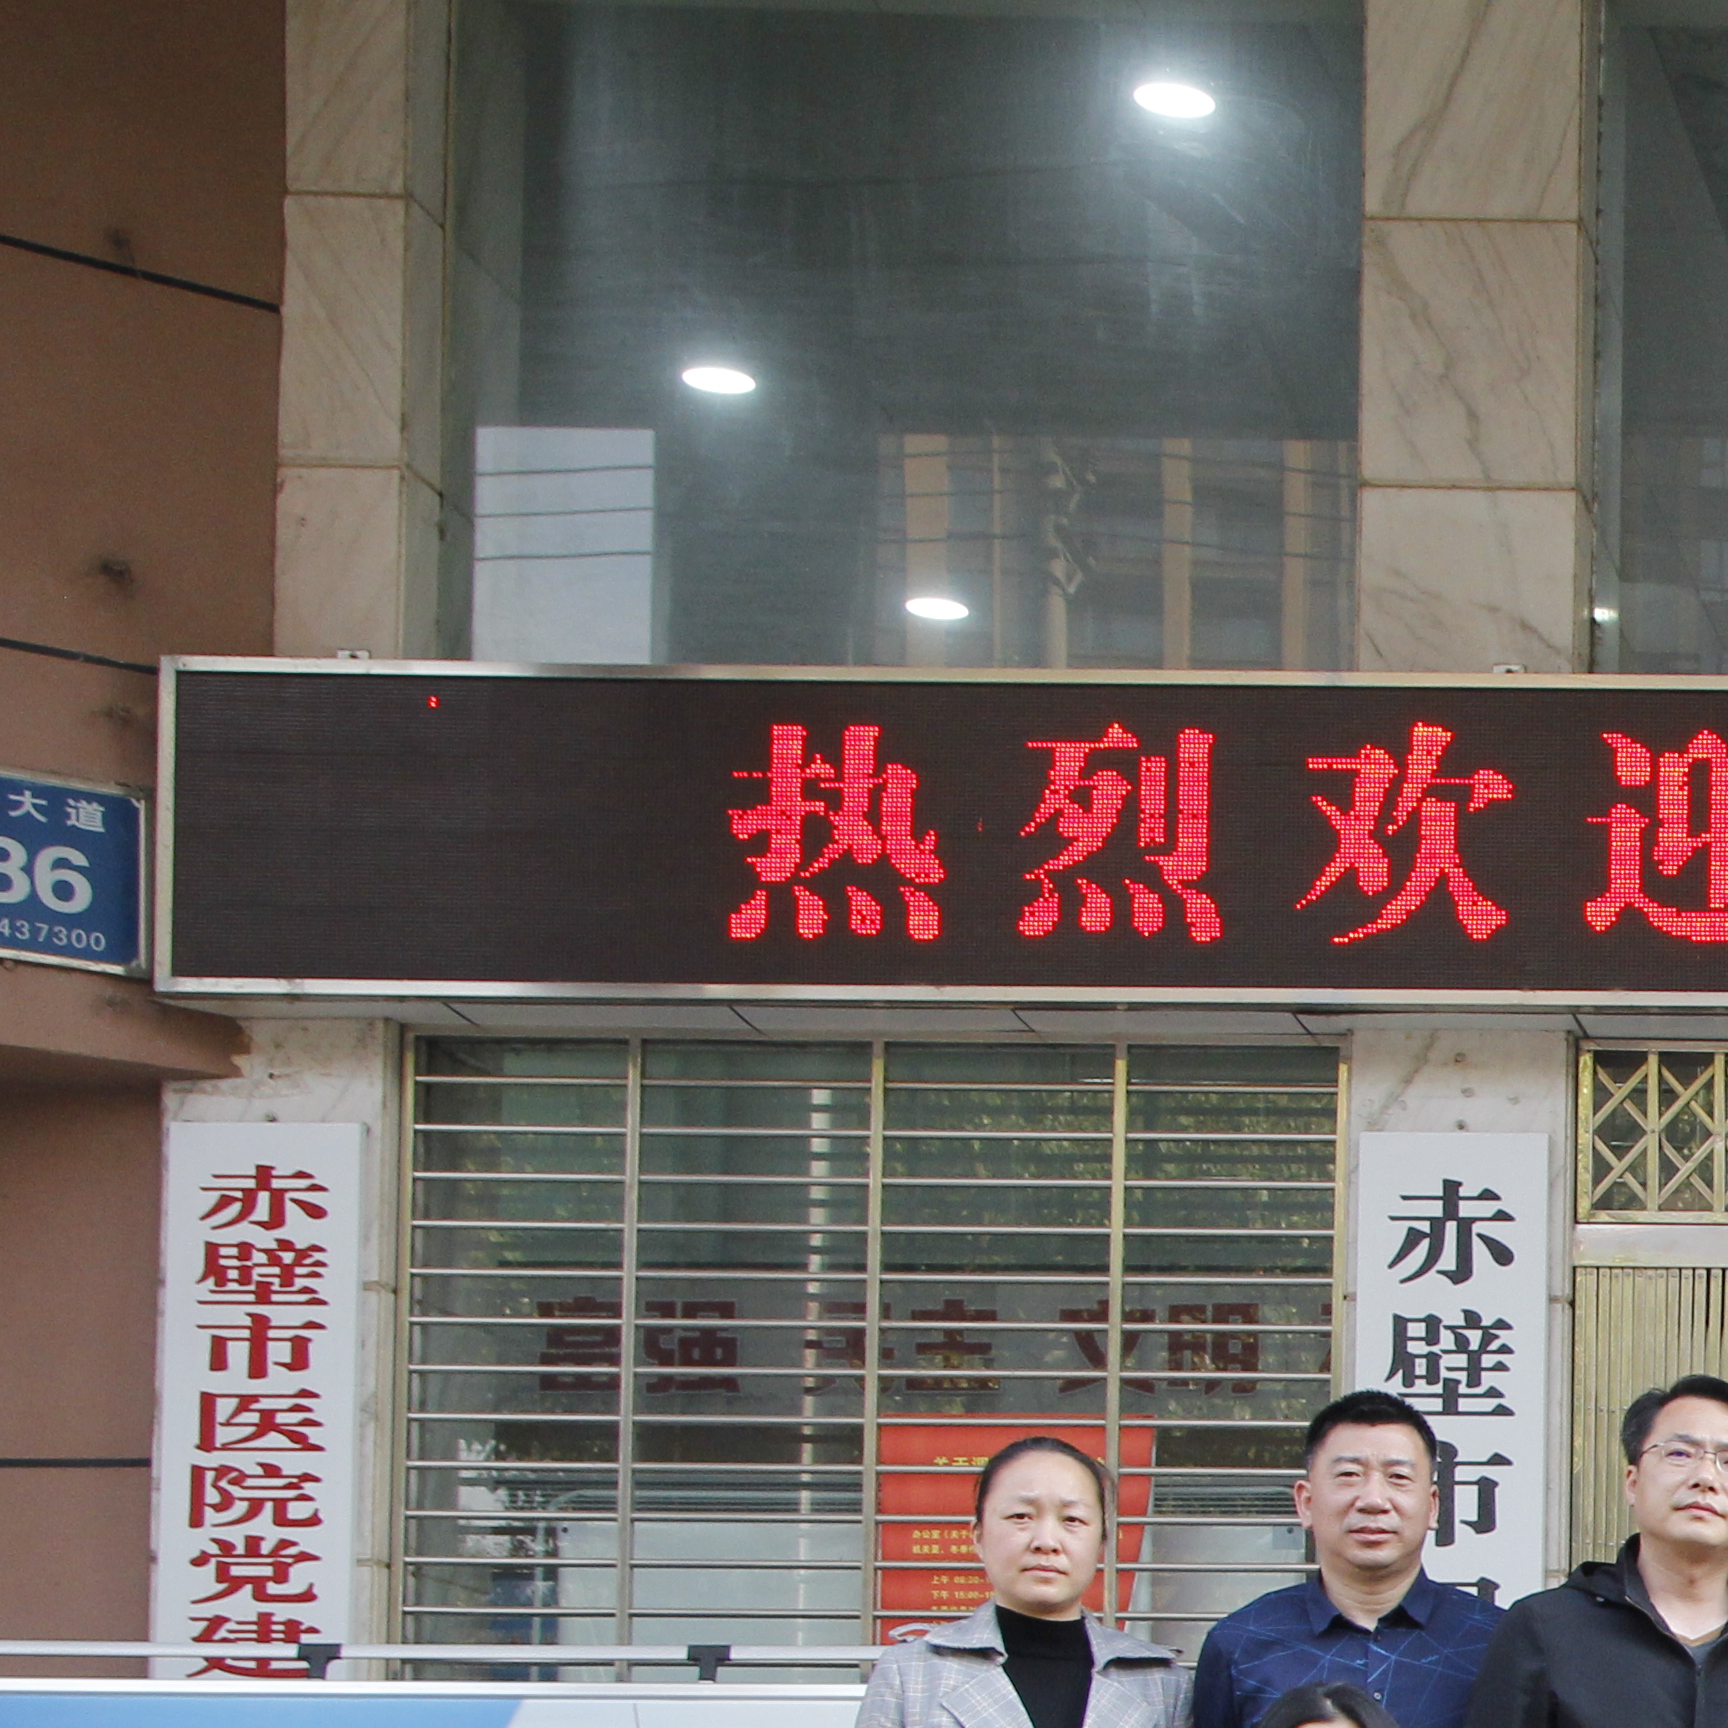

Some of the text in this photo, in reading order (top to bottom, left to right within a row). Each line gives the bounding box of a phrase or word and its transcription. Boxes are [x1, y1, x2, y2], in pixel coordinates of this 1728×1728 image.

[8, 789, 106, 833] 大道
[187, 1164, 331, 1678] 赤壁市医院党建
[1384, 1178, 1516, 1604] 赤壁市
